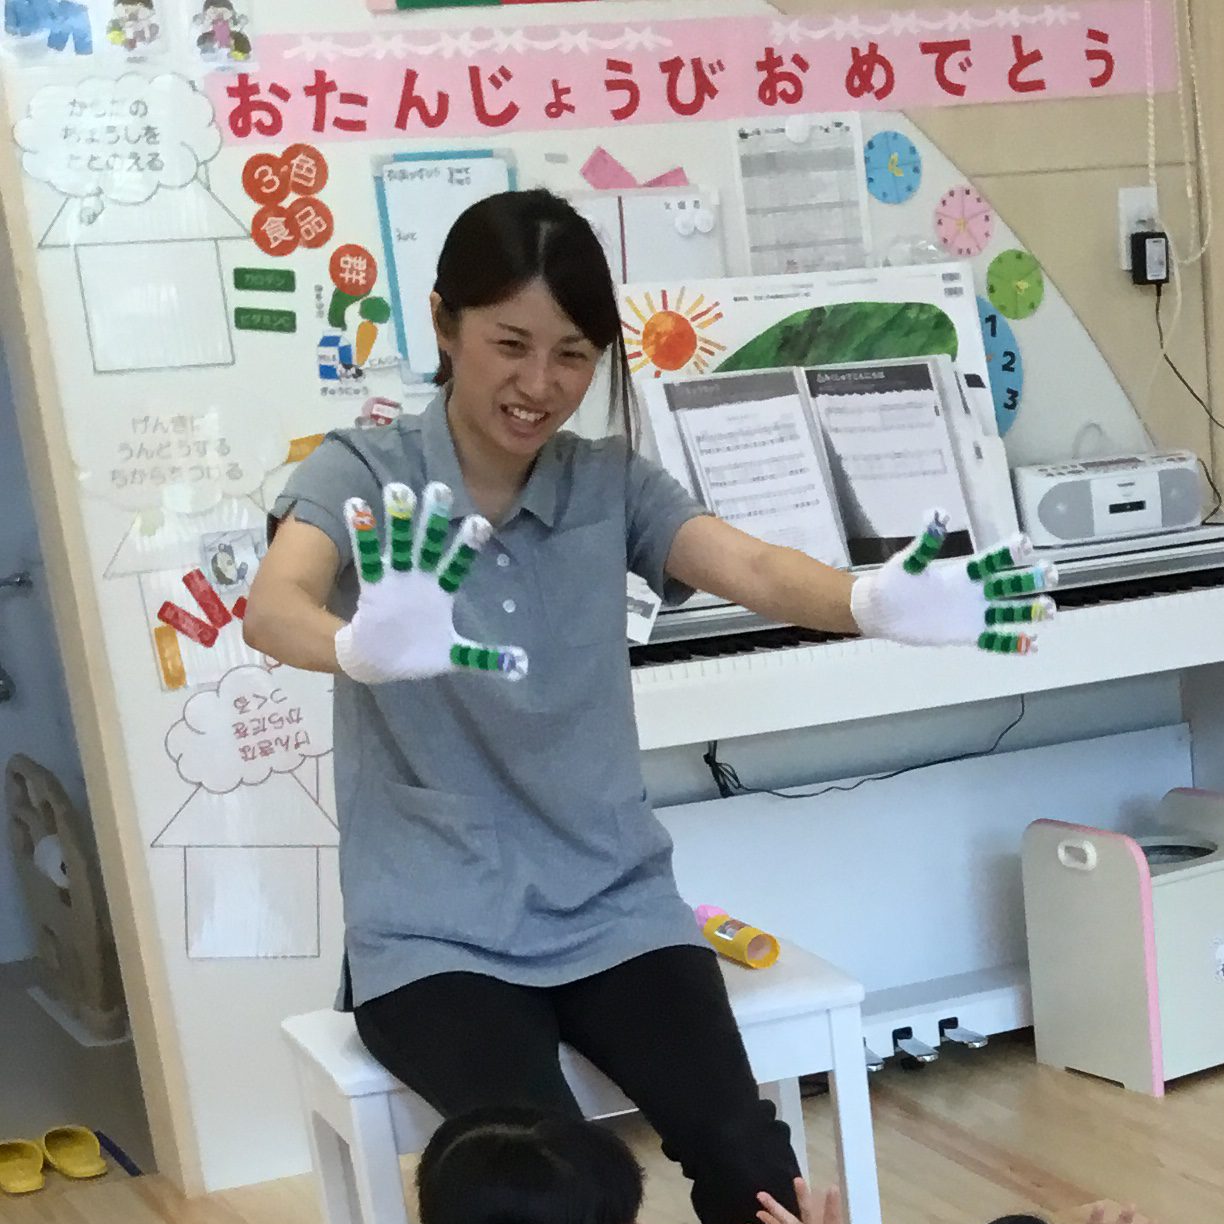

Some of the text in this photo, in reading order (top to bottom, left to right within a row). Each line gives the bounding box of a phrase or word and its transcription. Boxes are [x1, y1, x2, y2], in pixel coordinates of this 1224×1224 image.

[227, 29, 1115, 138] おたんじょうびおめでとう
[985, 314, 998, 338] 1
[1001, 350, 1017, 373] 2
[1003, 386, 1019, 411] 3
